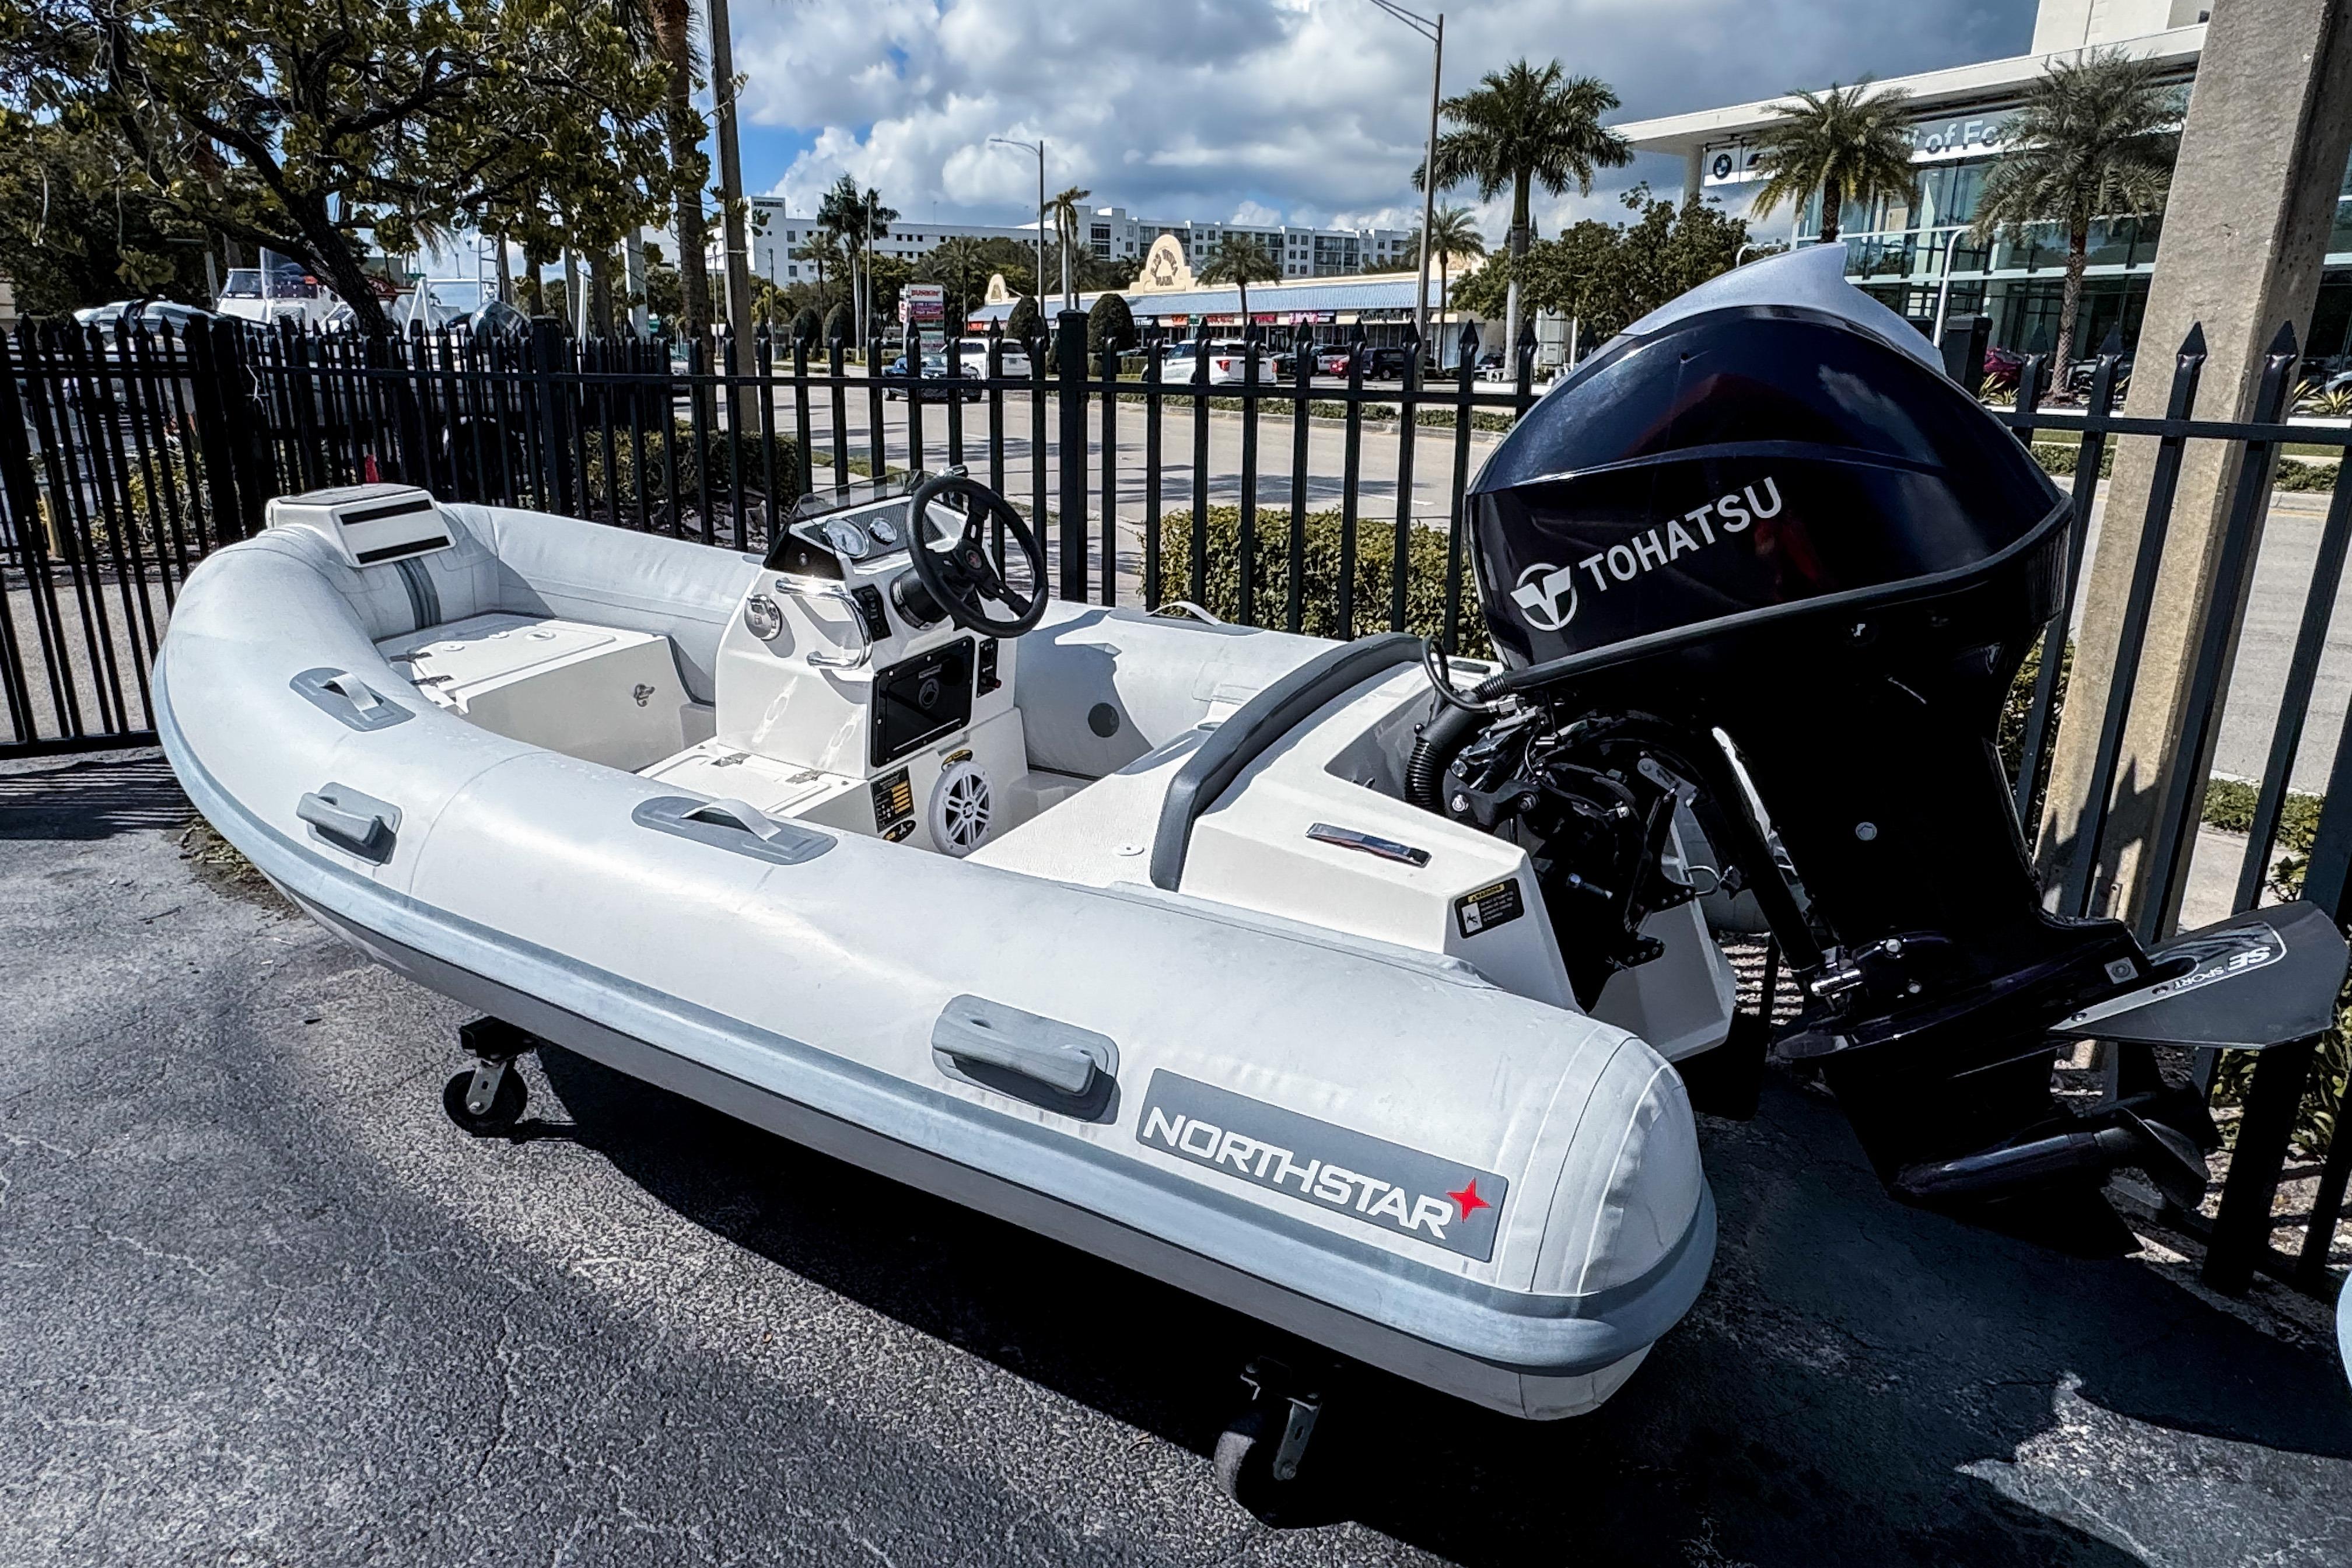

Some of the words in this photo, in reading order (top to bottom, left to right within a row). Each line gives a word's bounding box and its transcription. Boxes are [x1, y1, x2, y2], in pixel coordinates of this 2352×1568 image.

[1925, 123, 1957, 155] of
[1963, 120, 2002, 149] Fo
[1579, 476, 1782, 592] TOHATSU
[2227, 946, 2272, 971] SE
[2174, 966, 2225, 989] SPORT
[1142, 1106, 1454, 1240] NORTHSTAR
